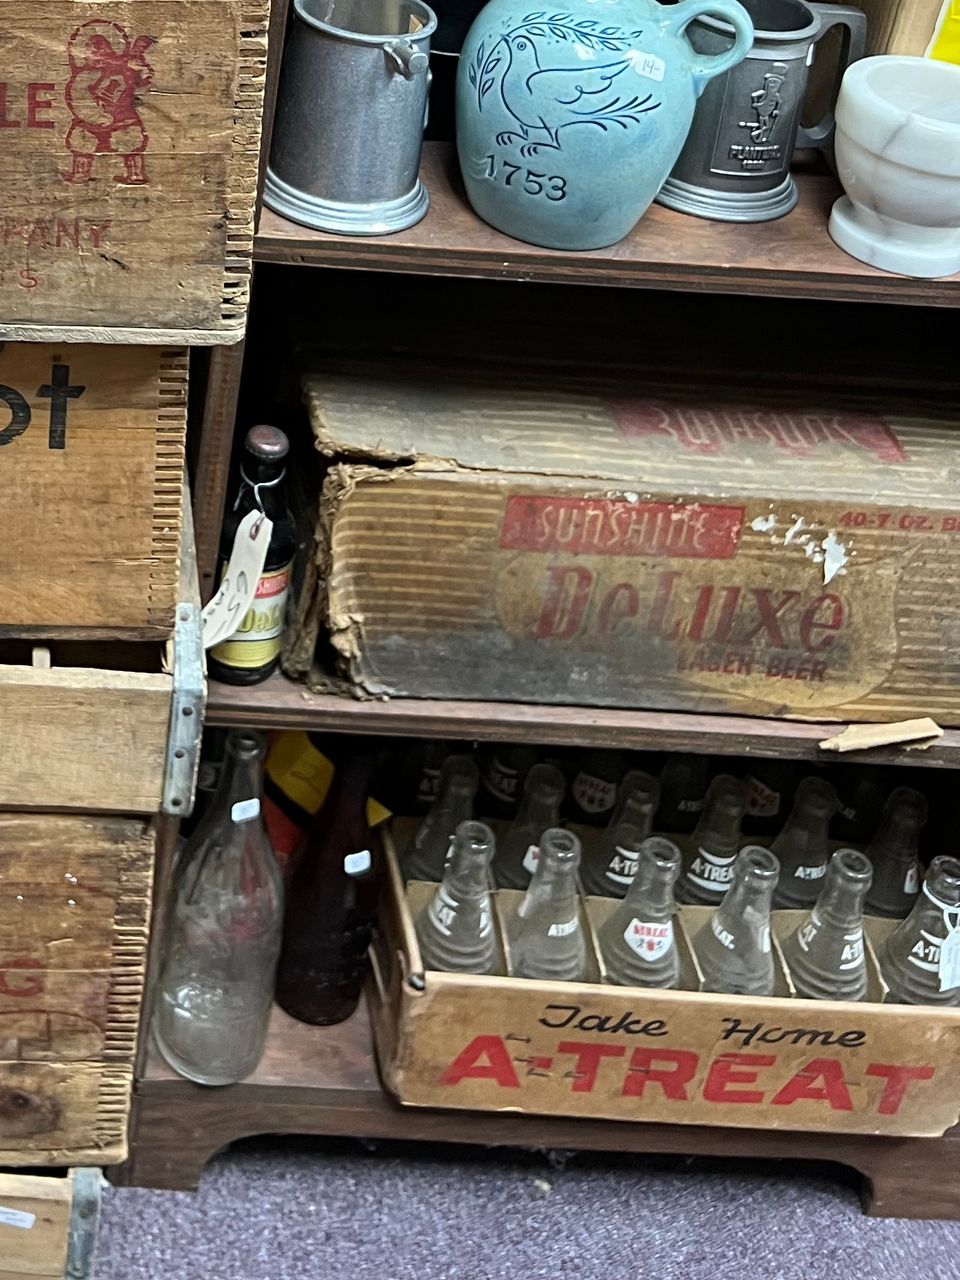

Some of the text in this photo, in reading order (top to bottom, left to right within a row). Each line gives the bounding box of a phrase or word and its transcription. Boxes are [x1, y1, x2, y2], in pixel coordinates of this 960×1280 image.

[484, 153, 568, 202] 1753
[764, 655, 830, 683] BEER
[691, 857, 735, 882] A-TREA
[539, 1004, 869, 1050] Take Home
[439, 1033, 938, 1116] A-TREAT
